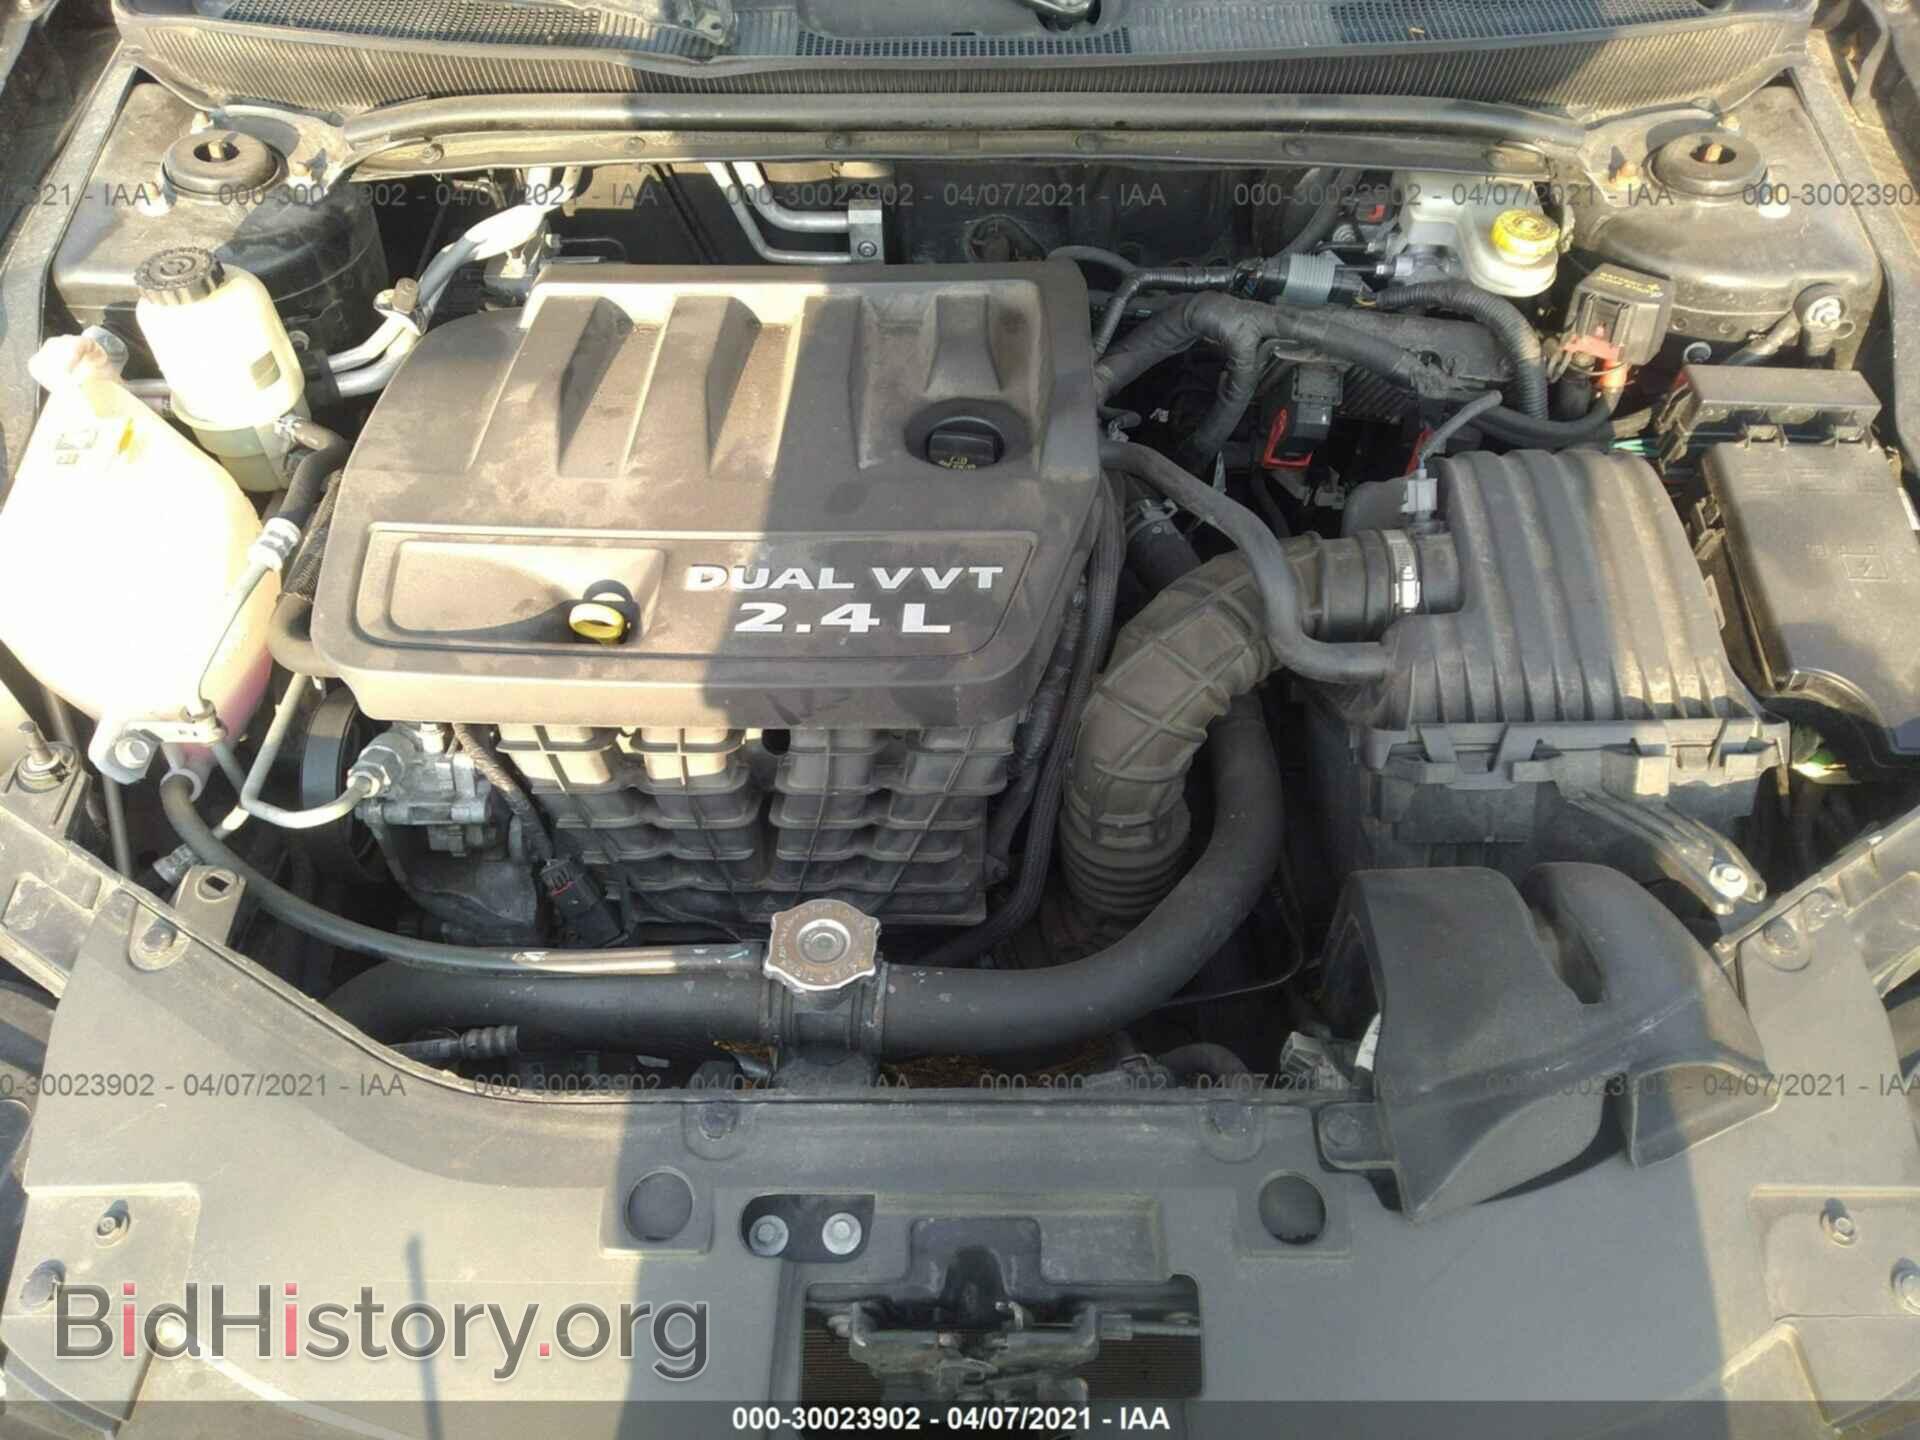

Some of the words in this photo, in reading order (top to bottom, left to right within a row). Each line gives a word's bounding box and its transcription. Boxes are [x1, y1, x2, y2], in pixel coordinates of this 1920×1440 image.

[685, 565, 855, 591] DUAL
[871, 566, 1003, 590] VVT
[734, 602, 880, 633] 2.4
[901, 603, 951, 633] L
